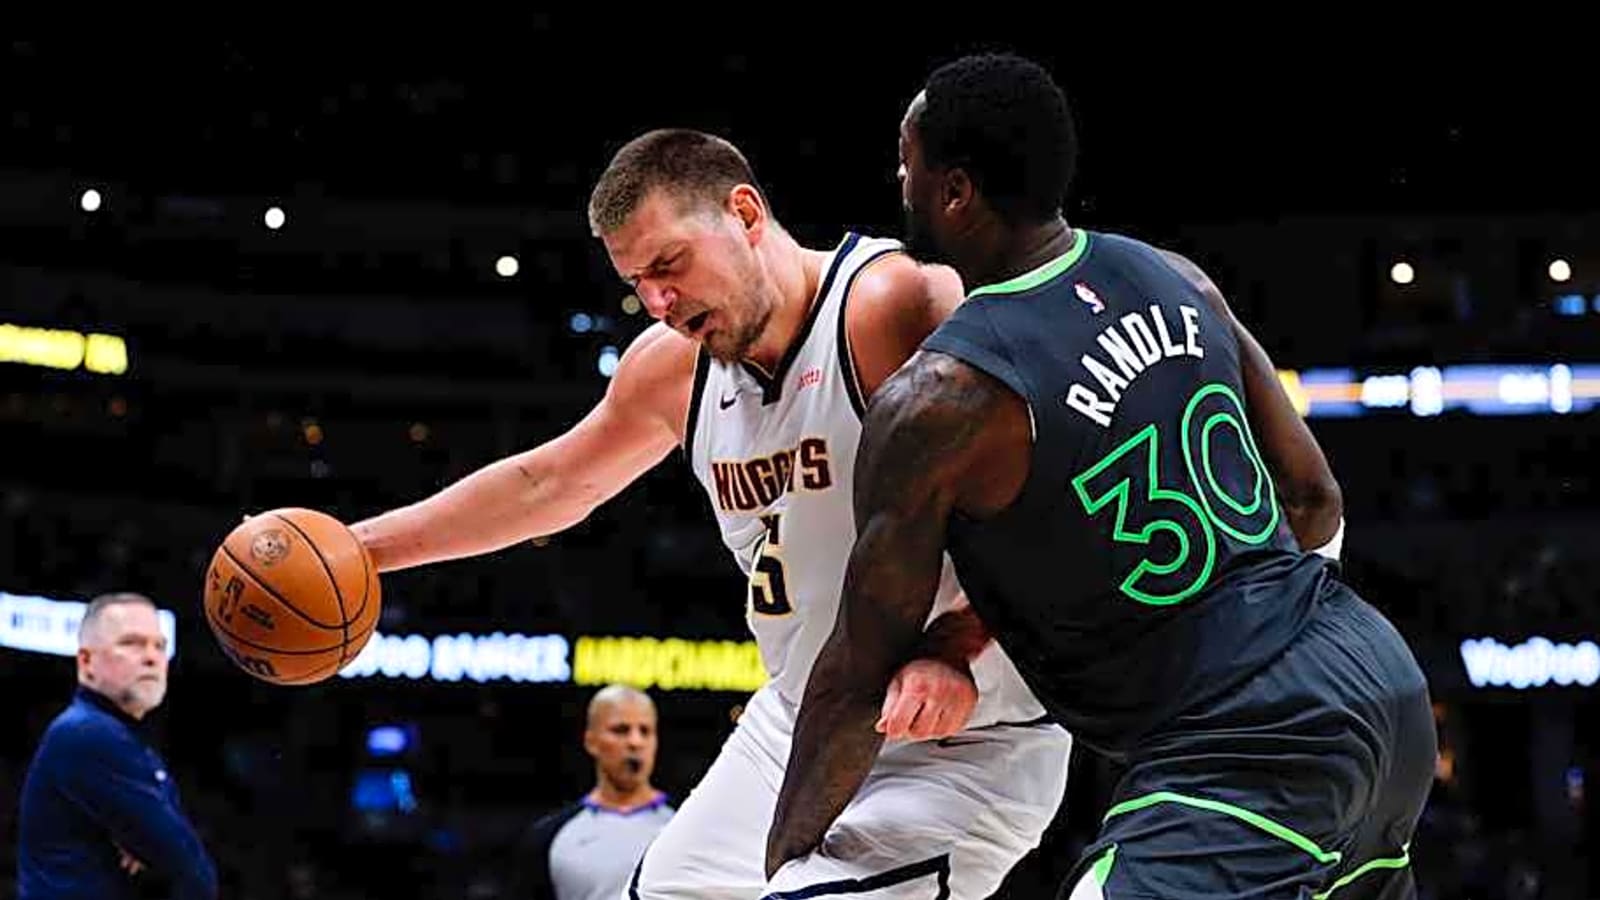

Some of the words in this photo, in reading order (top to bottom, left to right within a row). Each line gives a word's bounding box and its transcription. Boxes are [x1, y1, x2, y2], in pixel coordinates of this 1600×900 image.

[1066, 304, 1204, 428] RANDLE
[711, 437, 834, 513] NUGGS
[1071, 383, 1280, 606] 30
